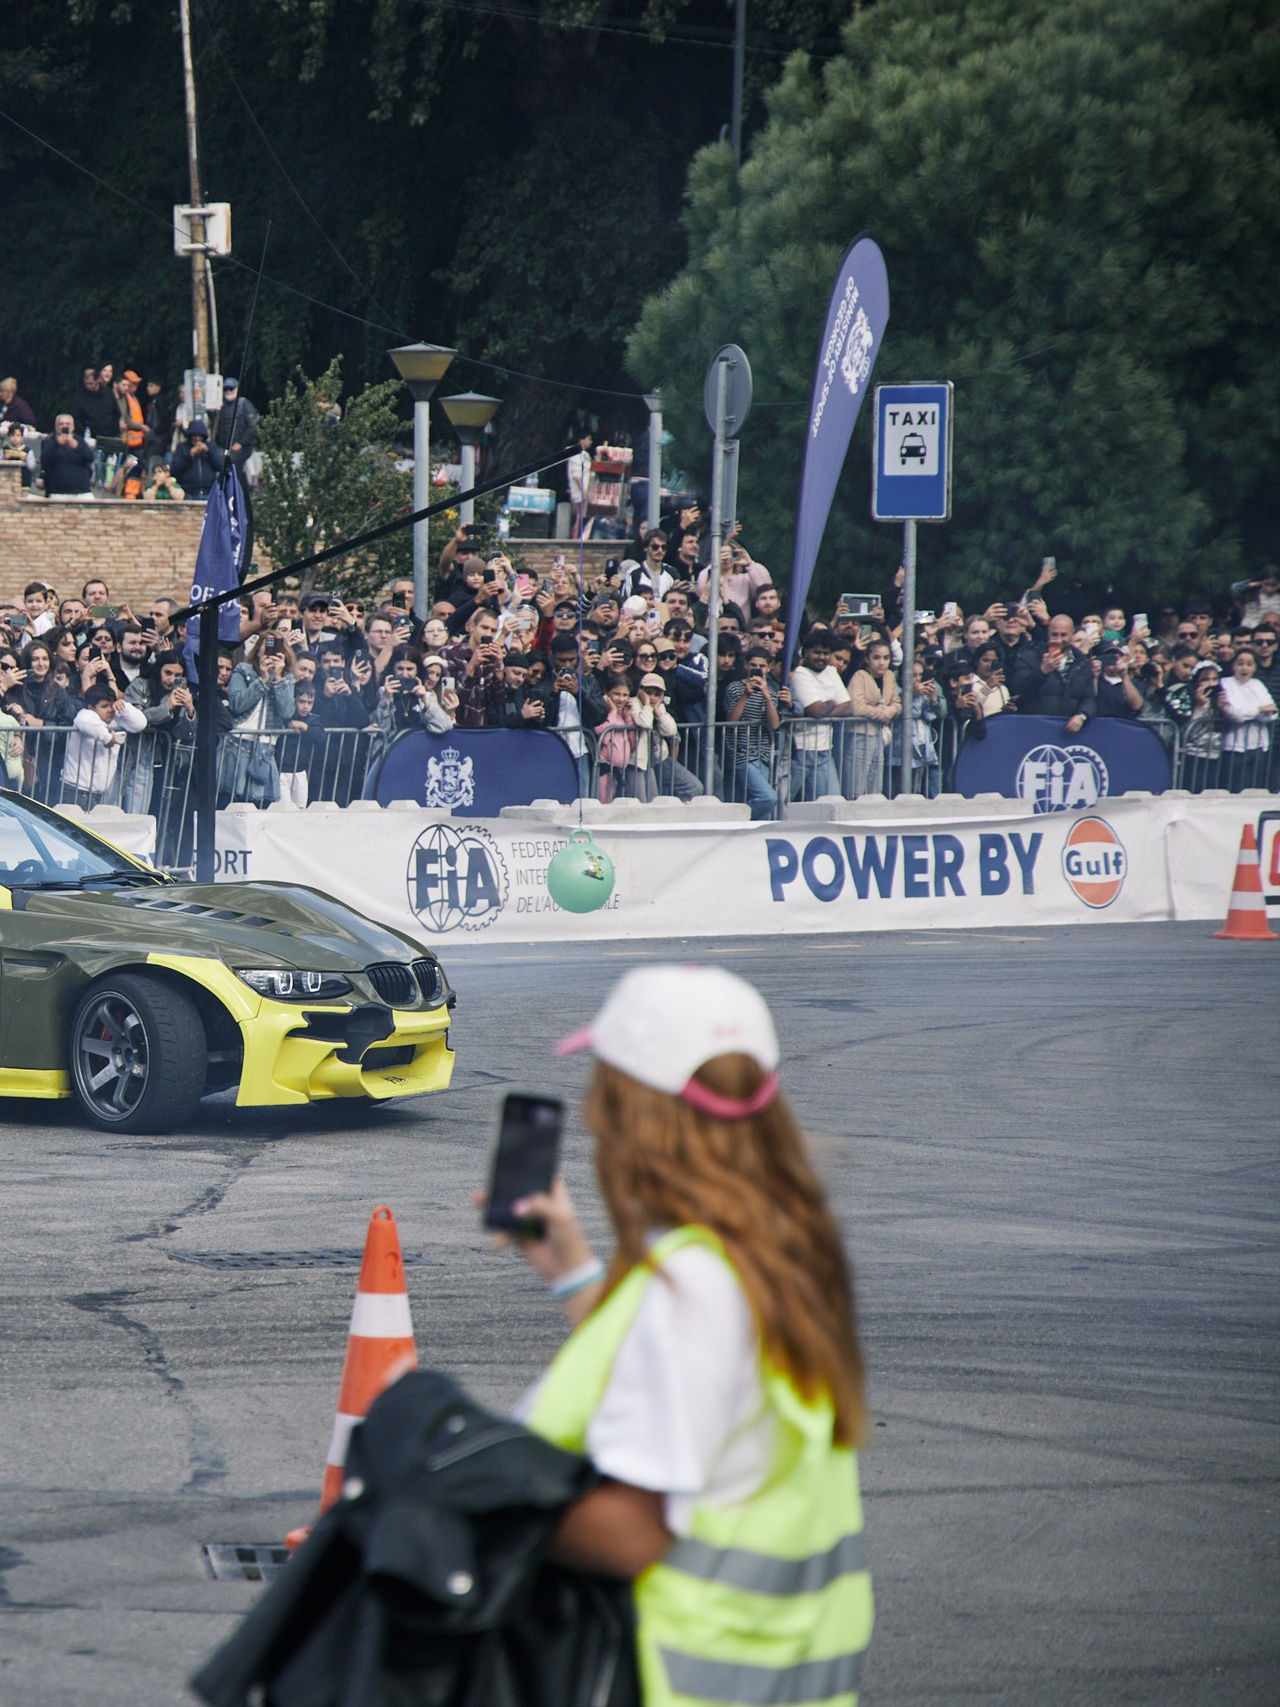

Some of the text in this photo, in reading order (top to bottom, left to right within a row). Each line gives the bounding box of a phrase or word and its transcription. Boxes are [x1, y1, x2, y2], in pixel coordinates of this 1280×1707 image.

[824, 276, 854, 366] OF GEORGIA
[813, 286, 859, 438] MINISTRY OF SPORT
[889, 411, 936, 426] TAXI
[765, 831, 1044, 902] POWER BY
[1065, 850, 1124, 876] Gulf
[516, 896, 534, 913] DE
